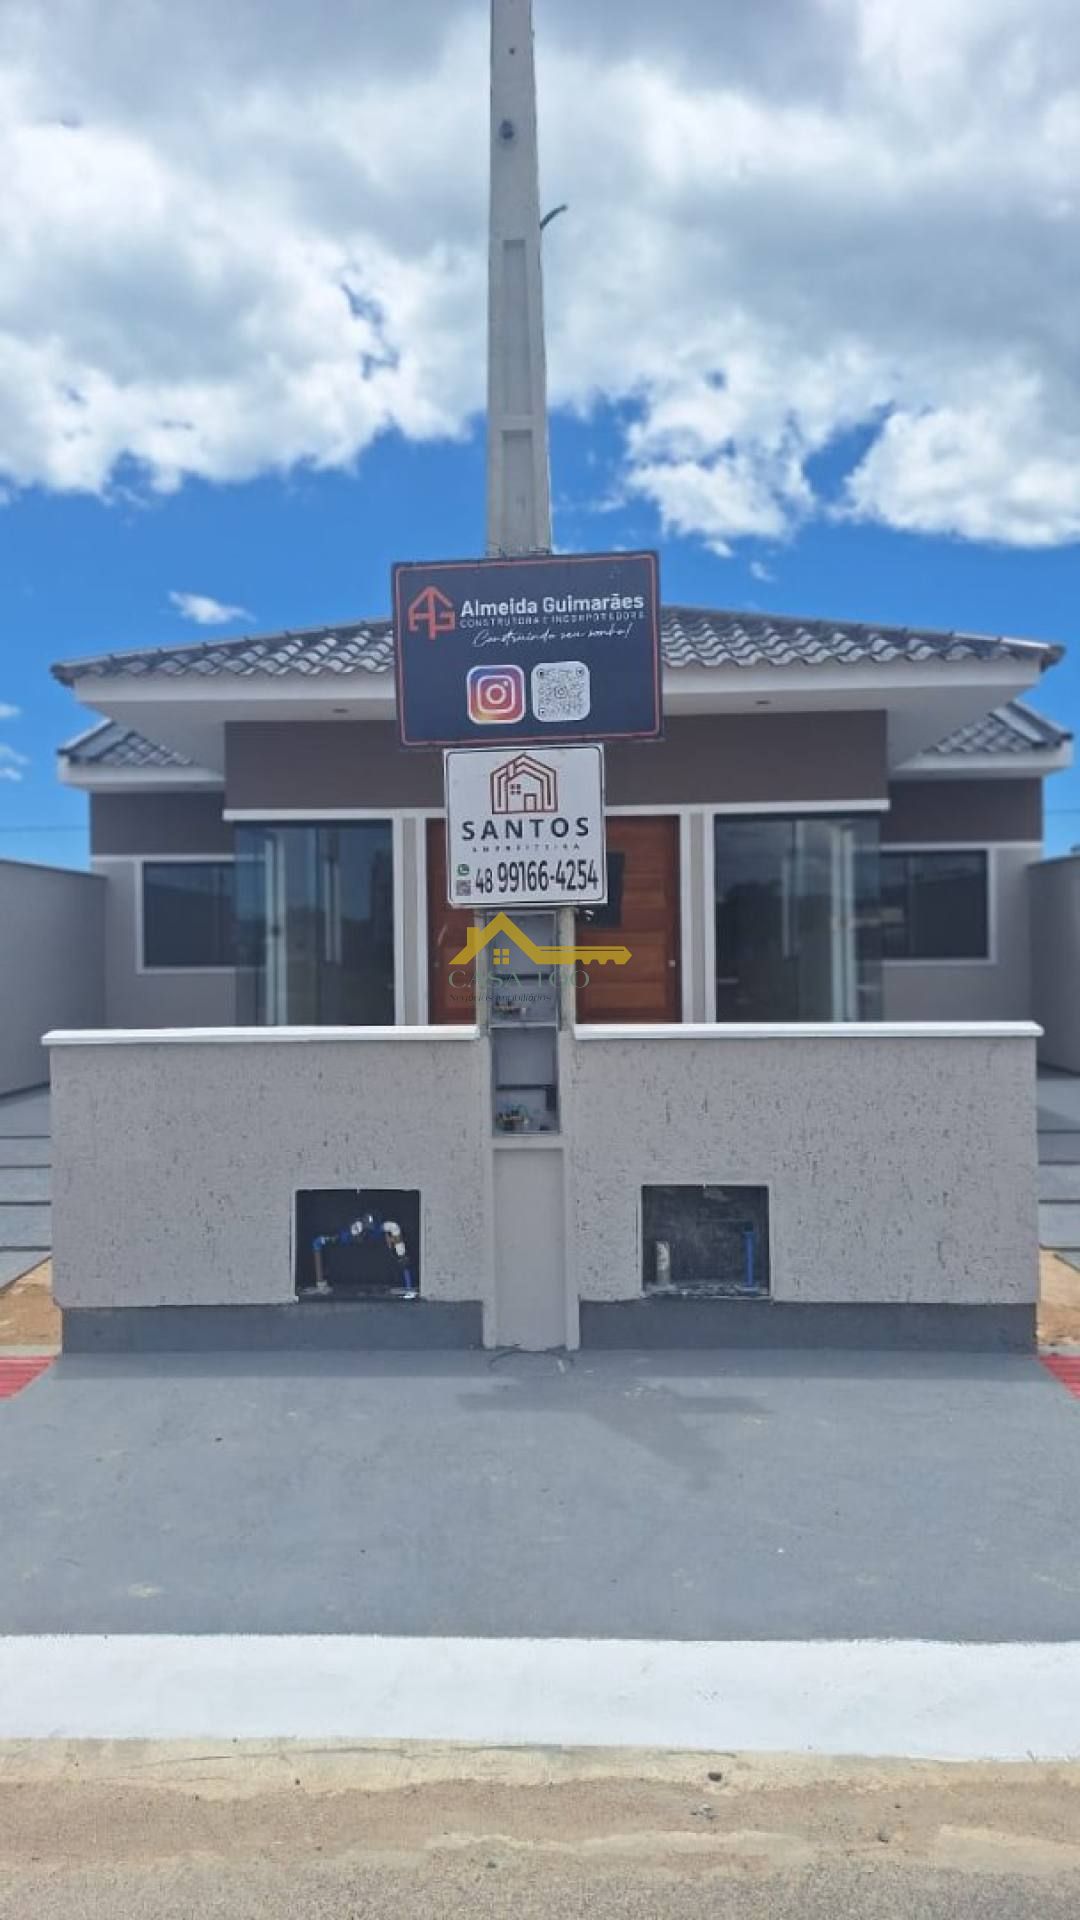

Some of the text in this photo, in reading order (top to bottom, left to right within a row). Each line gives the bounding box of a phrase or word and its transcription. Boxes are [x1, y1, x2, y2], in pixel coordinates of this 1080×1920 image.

[460, 593, 645, 618] Almeida Guimarães
[459, 616, 539, 629] CONSTRUTORA
[461, 817, 589, 840] SANTOS
[475, 859, 598, 894] 48 99166-4254
